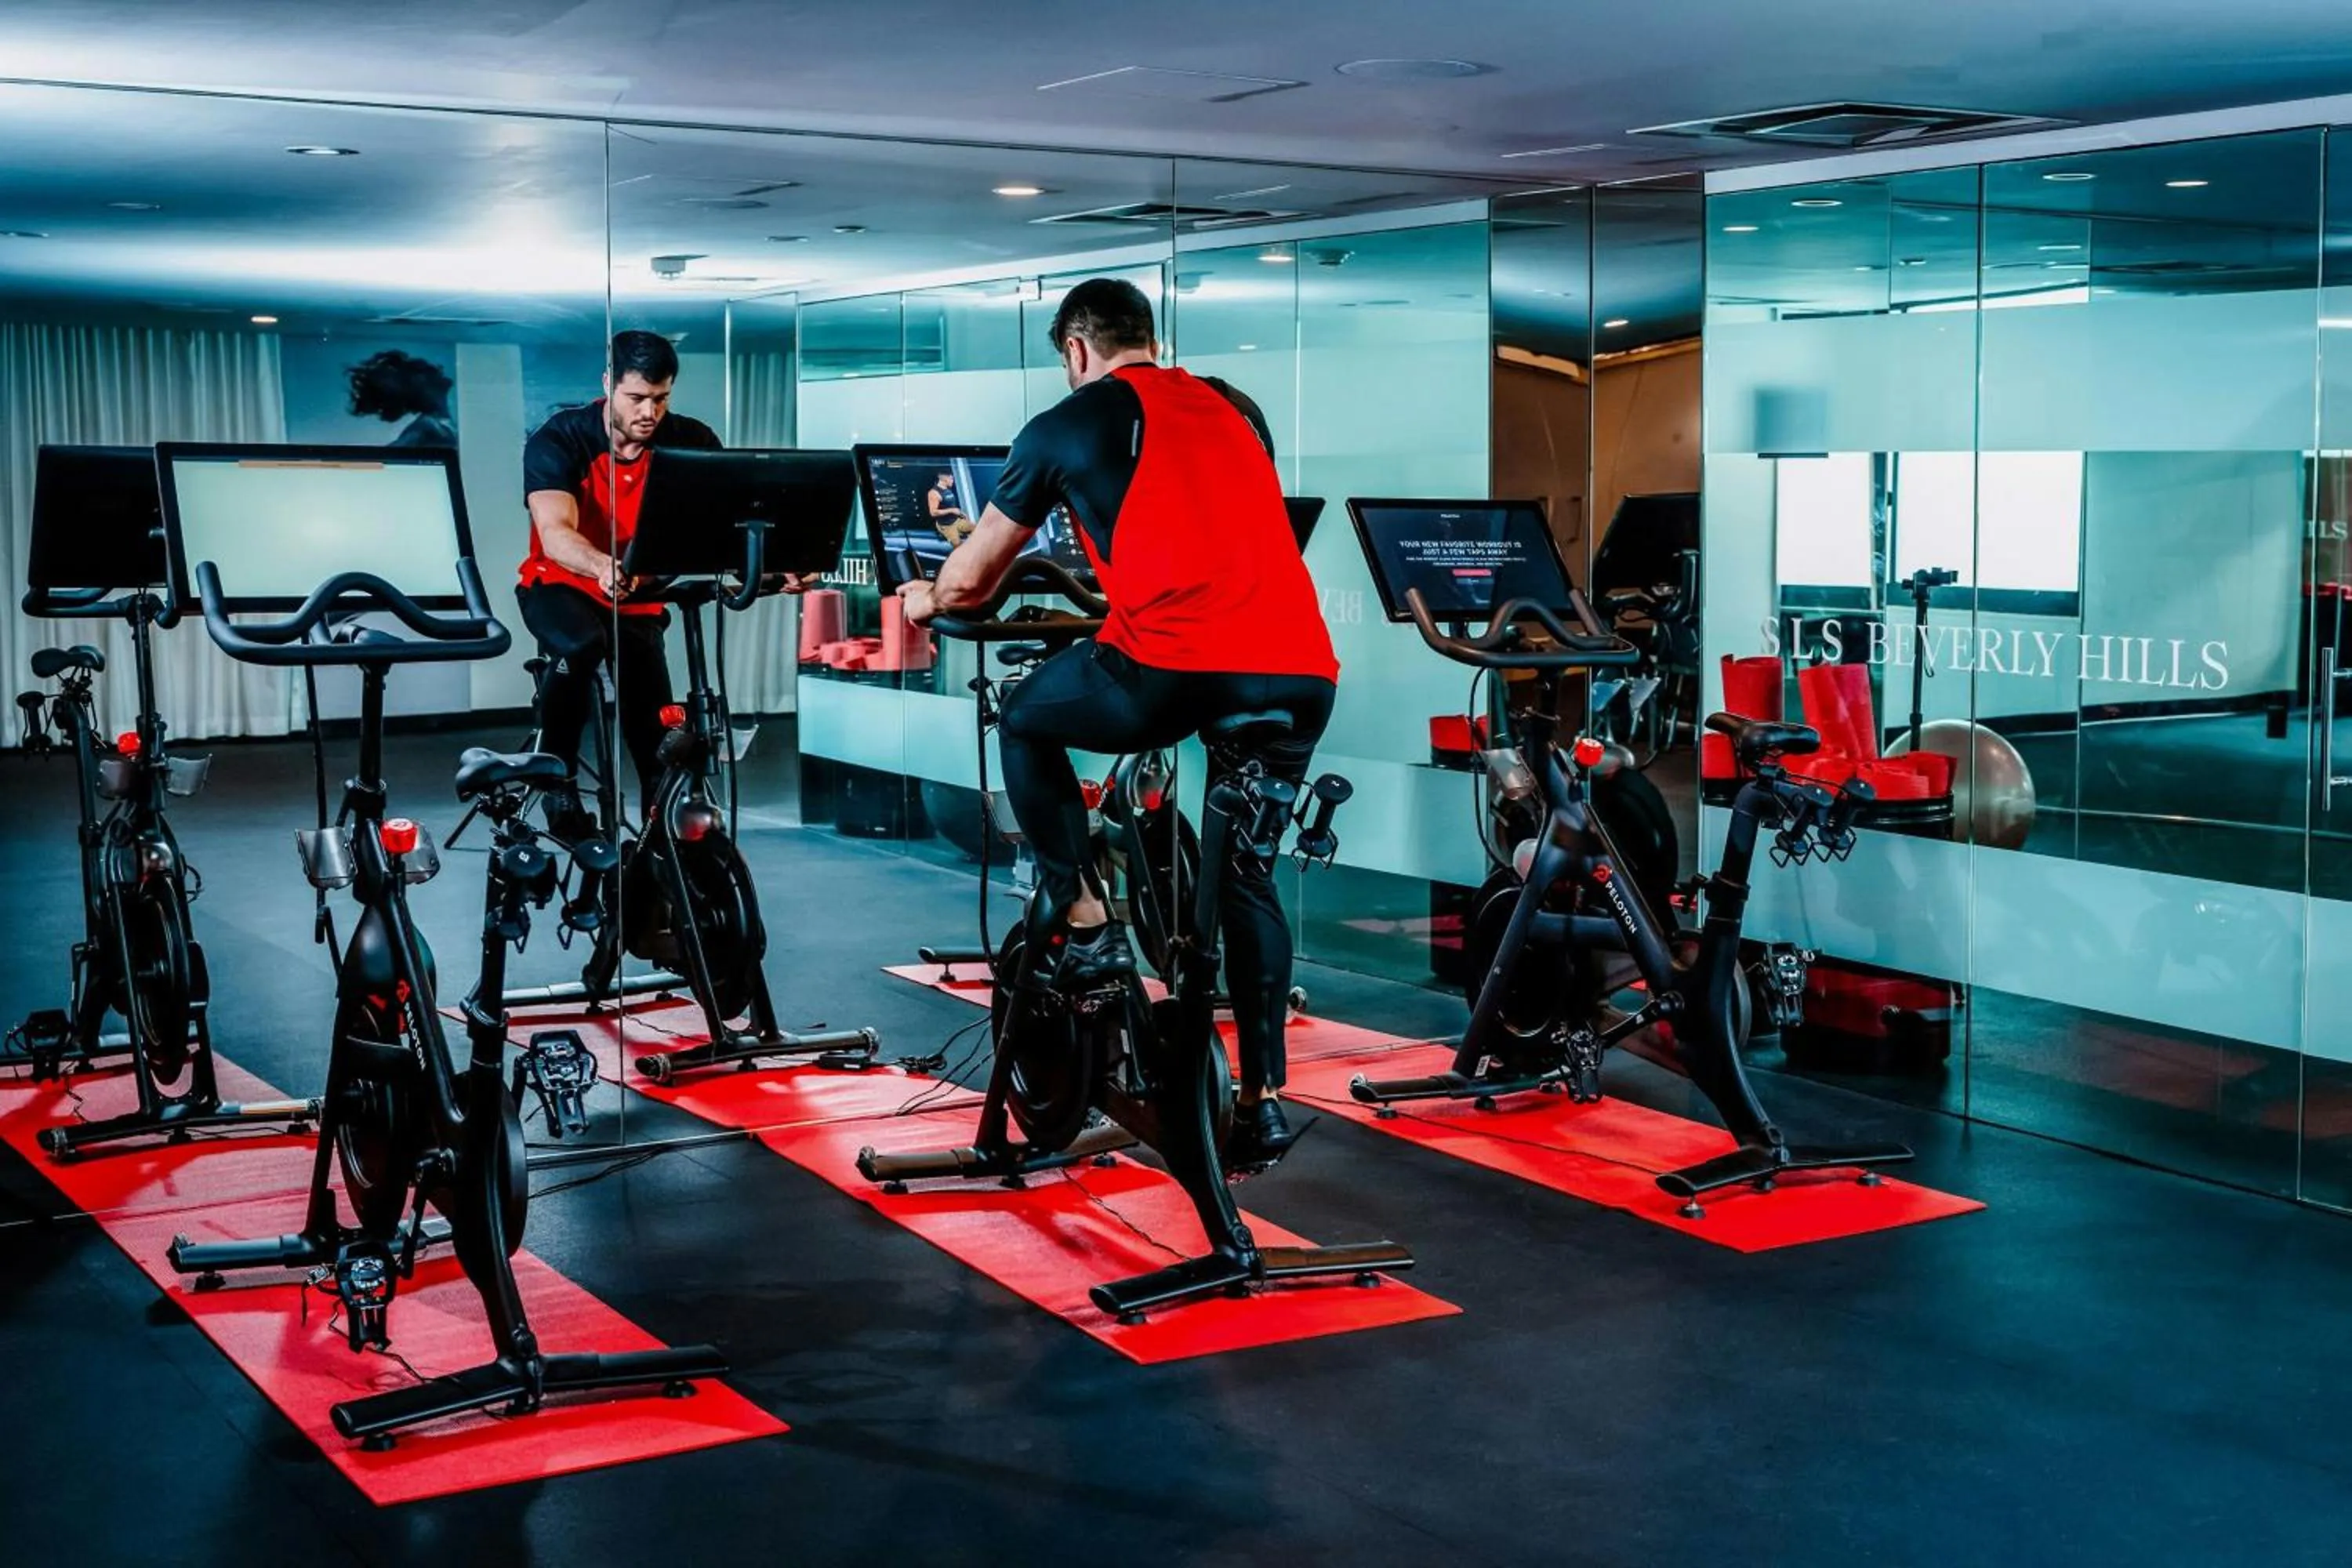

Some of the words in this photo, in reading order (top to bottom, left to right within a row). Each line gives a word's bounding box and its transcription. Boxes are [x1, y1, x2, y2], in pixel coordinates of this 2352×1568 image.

[1761, 616, 1842, 662] SLS
[1865, 622, 2063, 677] BEVERLY
[2076, 634, 2229, 691] HILLS
[1605, 880, 1638, 934] PELOTON
[404, 1002, 426, 1071] PELOTON
